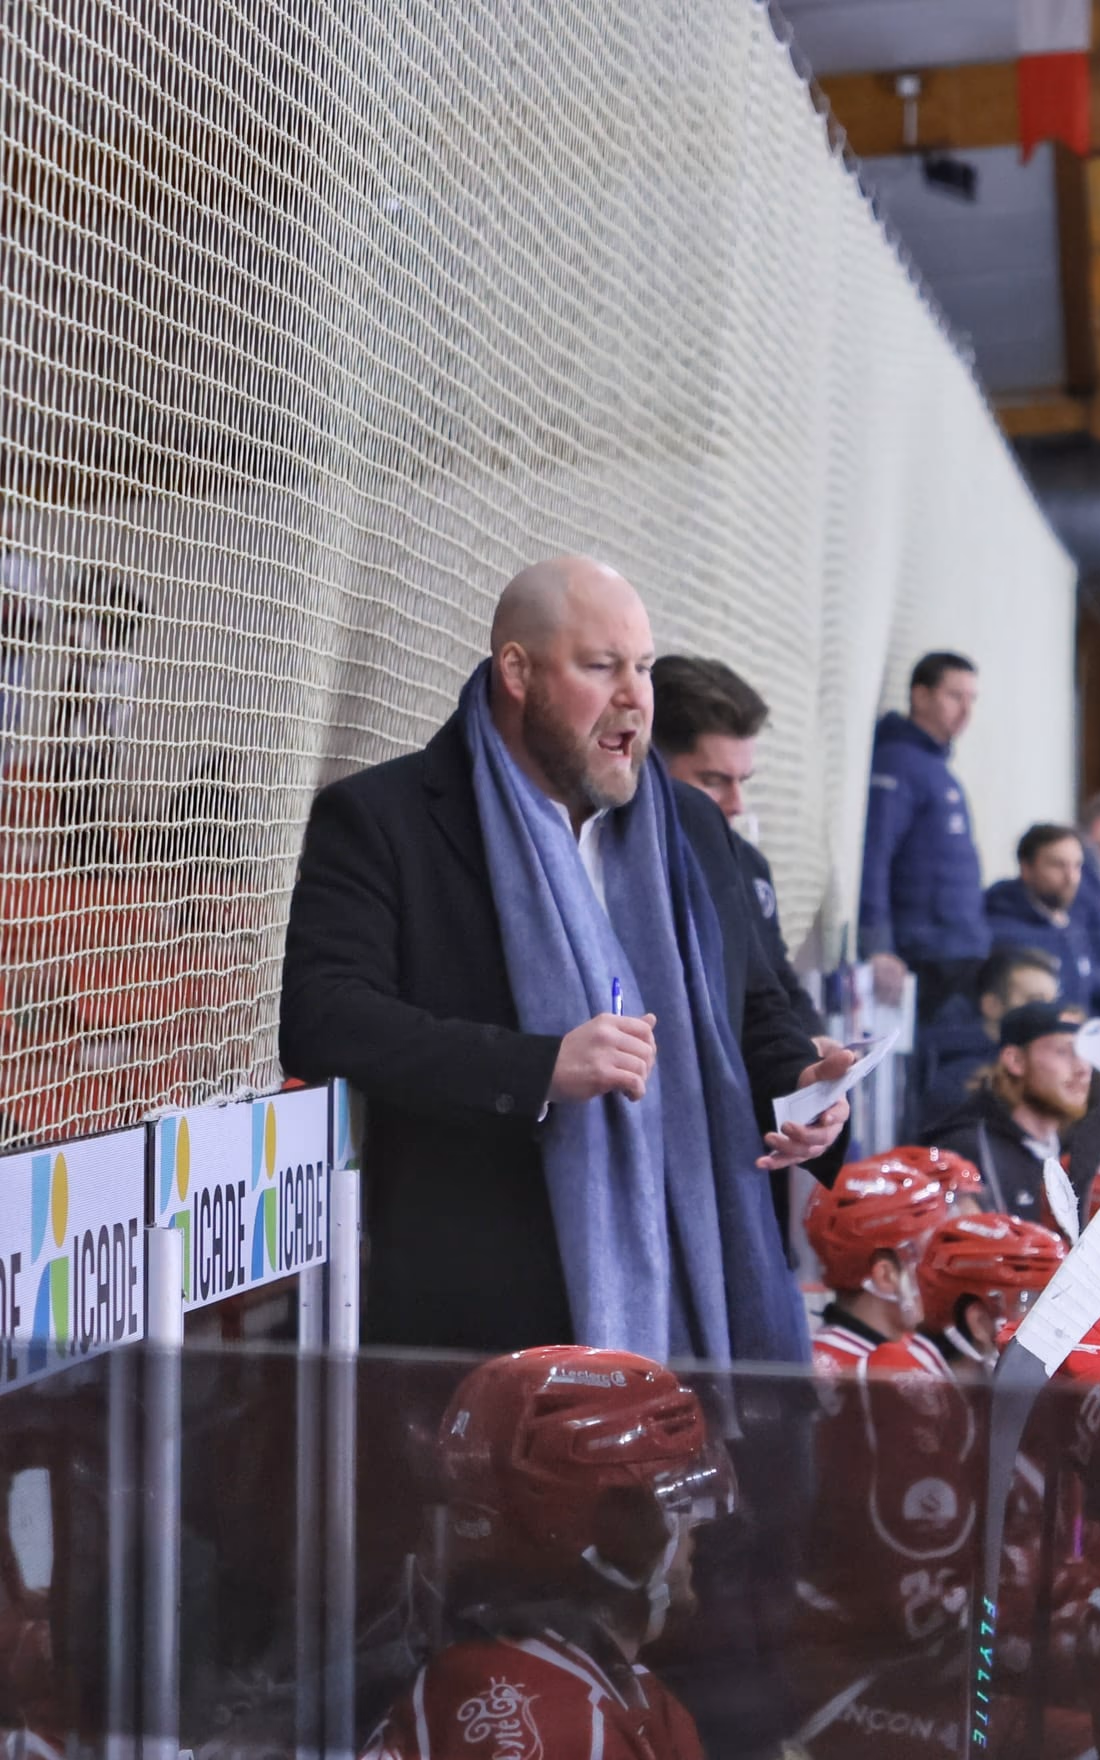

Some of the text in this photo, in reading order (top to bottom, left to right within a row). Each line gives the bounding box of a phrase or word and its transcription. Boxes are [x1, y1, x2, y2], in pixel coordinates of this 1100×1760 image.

[193, 1180, 246, 1301] ICADE
[279, 1161, 323, 1271] ICADE
[71, 1217, 138, 1355] ICADE
[973, 1595, 998, 1749] FLYLITE
